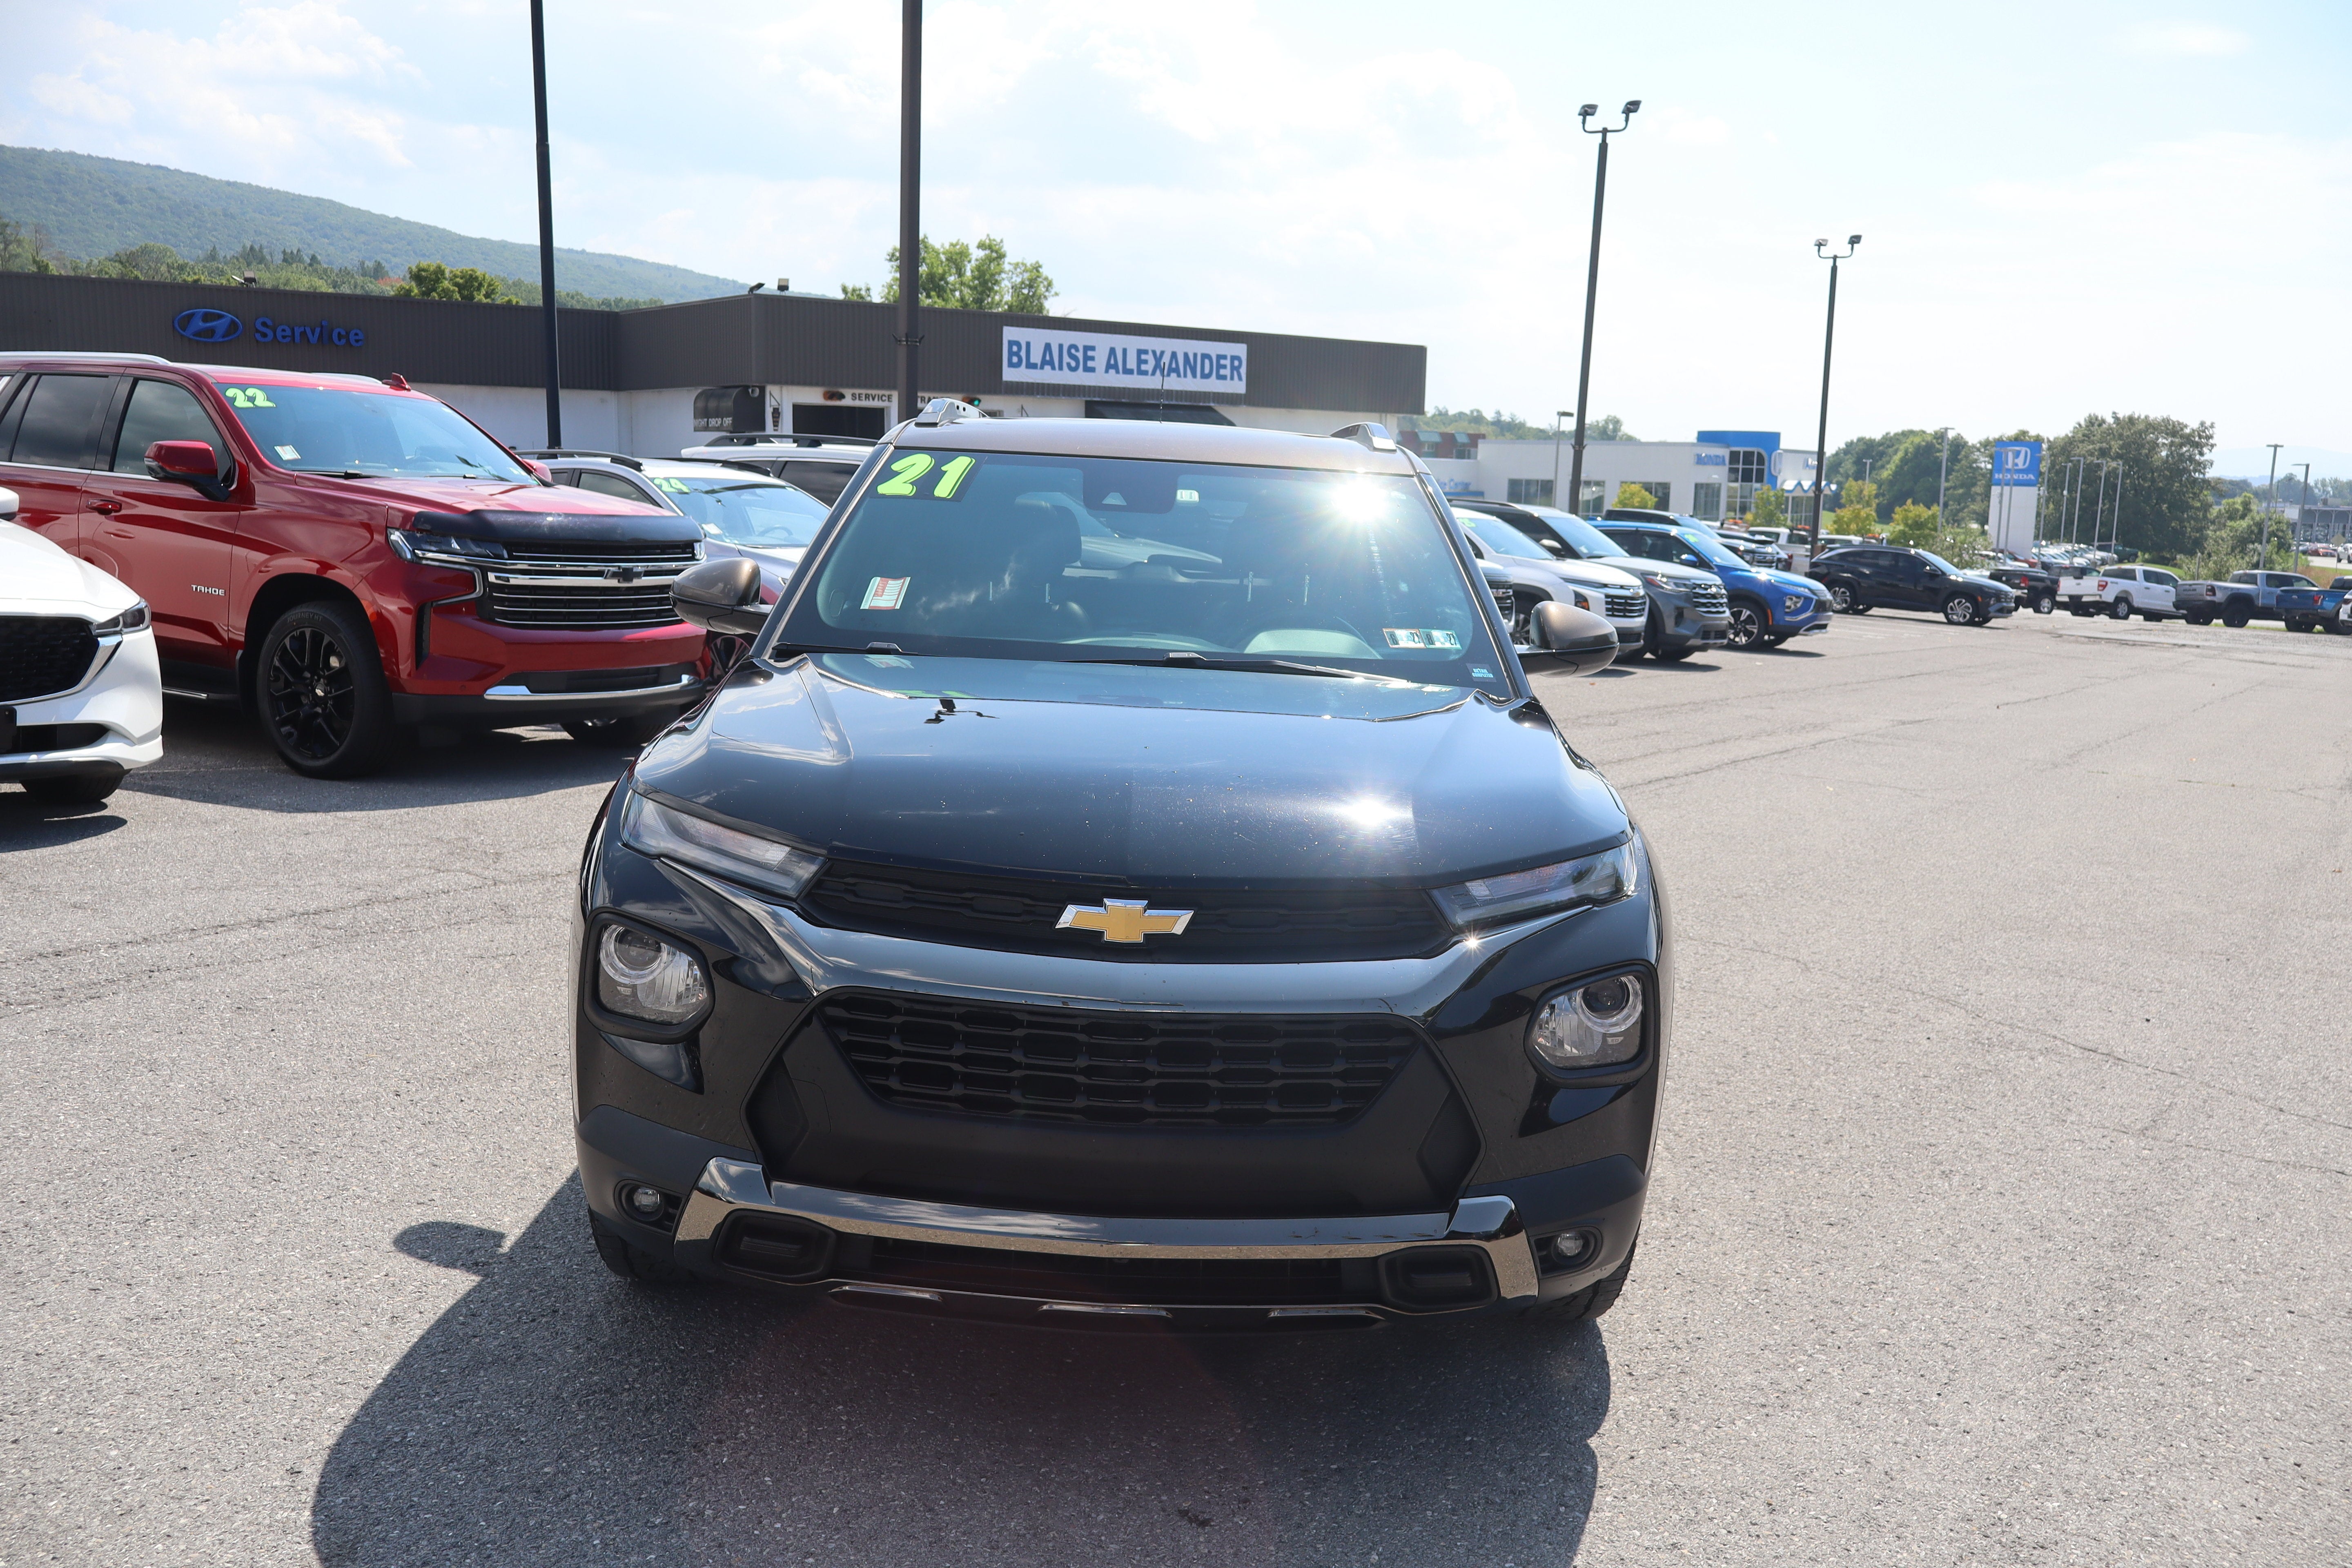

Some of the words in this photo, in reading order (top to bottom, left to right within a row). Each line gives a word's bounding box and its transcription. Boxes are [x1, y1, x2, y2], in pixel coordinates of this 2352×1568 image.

[254, 317, 364, 346] Service
[1007, 339, 1096, 373] BLAISE
[1104, 346, 1243, 381] ALEXANDER
[225, 387, 276, 408] 22
[851, 393, 893, 403] SERVICE
[708, 417, 722, 427] DROP
[723, 417, 732, 426] OFF
[1696, 453, 1726, 466] HONDA
[877, 453, 976, 499] 21
[653, 477, 691, 493] 24
[191, 584, 225, 596] TAHOE
